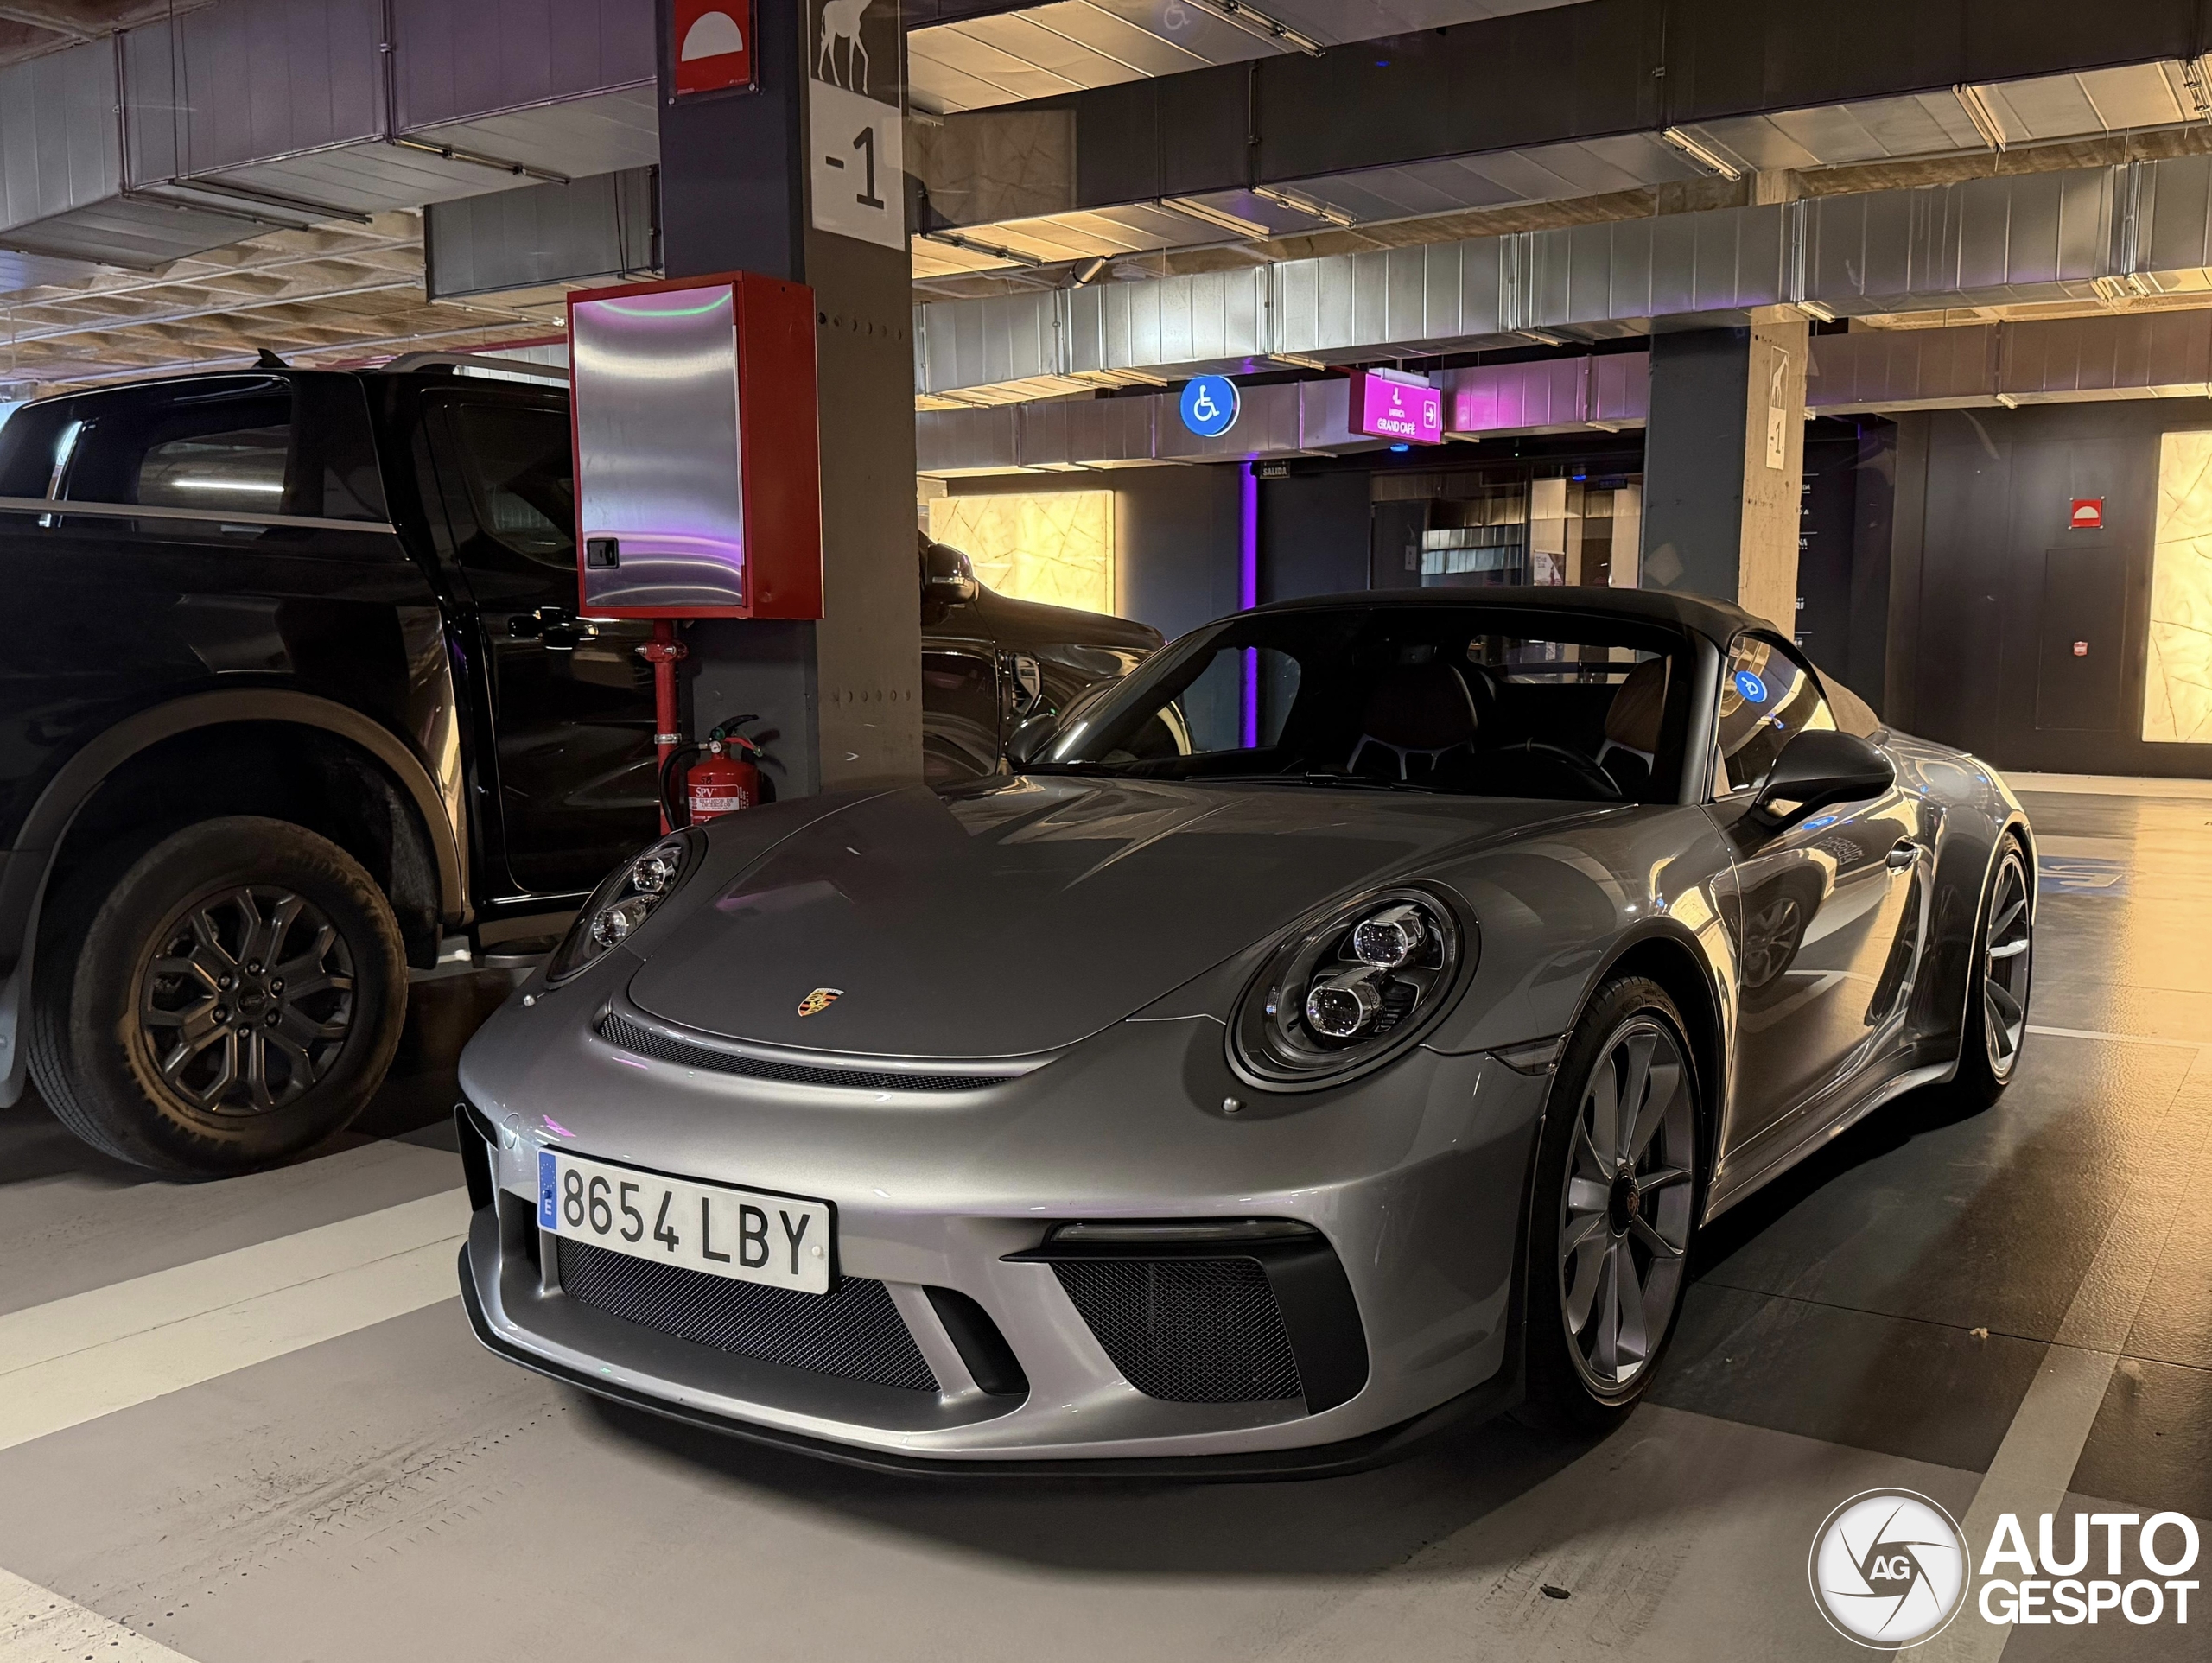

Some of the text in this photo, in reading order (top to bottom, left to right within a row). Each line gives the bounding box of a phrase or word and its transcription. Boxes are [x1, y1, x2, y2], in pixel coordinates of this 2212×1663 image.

[825, 126, 885, 210] -1
[1377, 417, 1416, 435] GRAND CAFÉ
[1262, 466, 1287, 476] SALIDA
[696, 787, 714, 797] SPV
[544, 1198, 553, 1216] E
[563, 1169, 811, 1275] 8654 LBY
